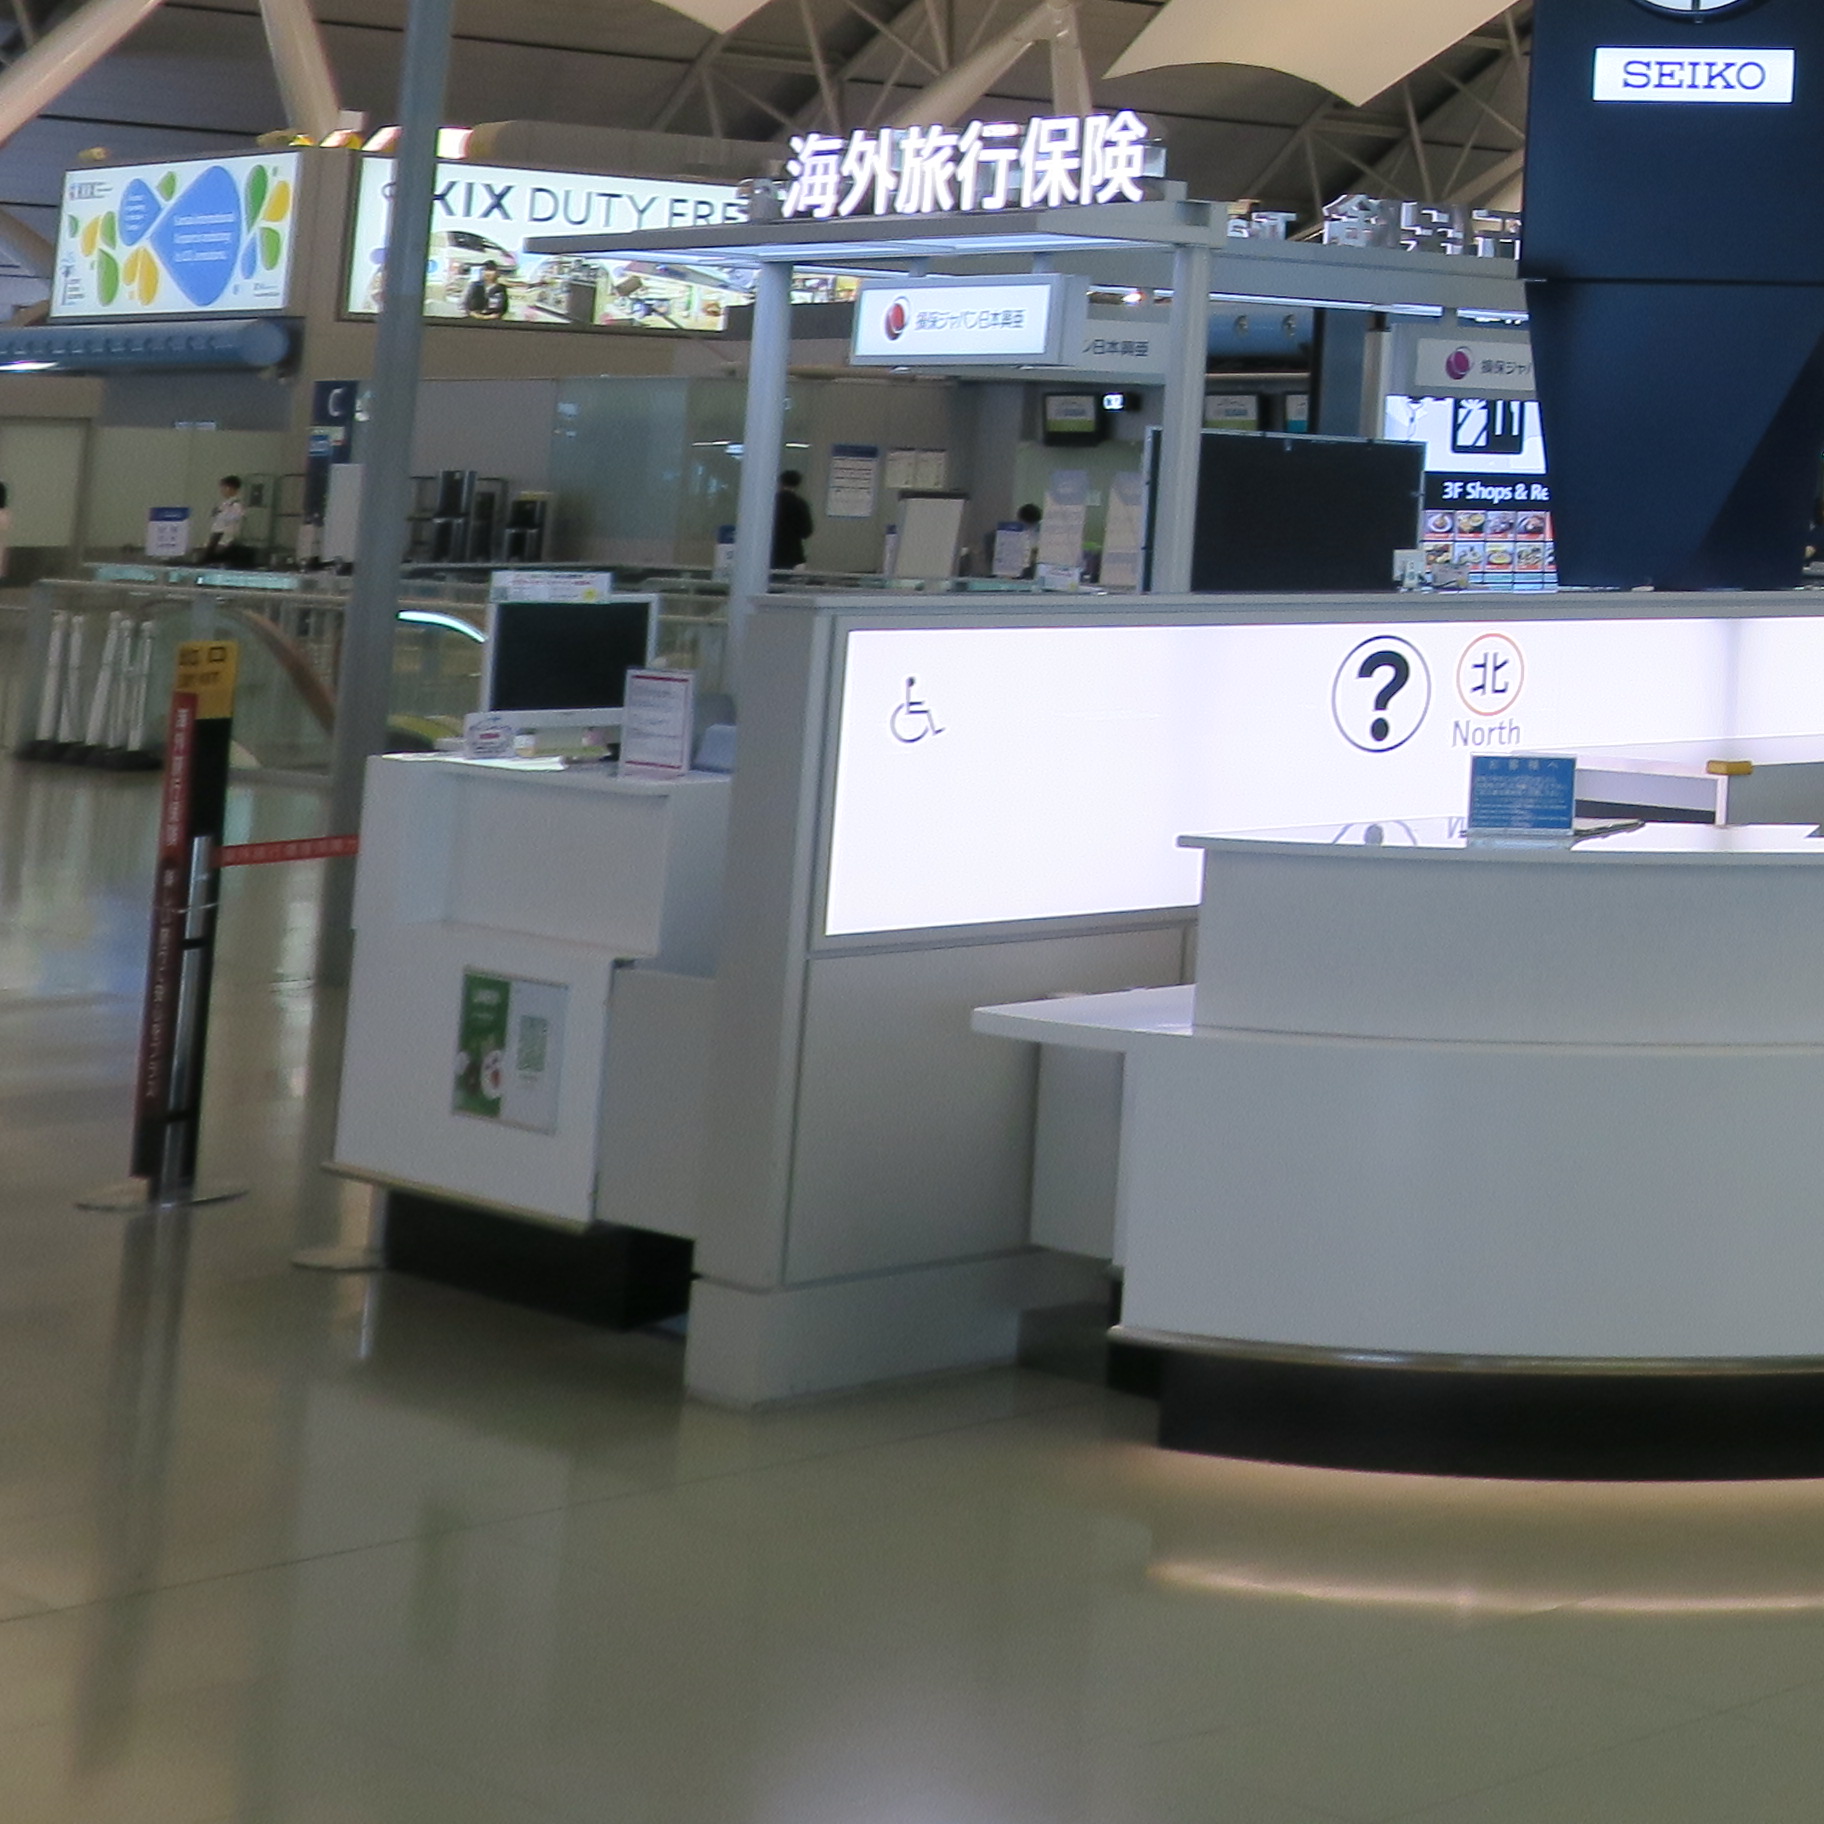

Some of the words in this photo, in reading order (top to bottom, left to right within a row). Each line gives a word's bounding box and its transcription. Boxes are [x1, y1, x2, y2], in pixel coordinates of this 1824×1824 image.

[1622, 60, 1767, 90] SEIKO
[781, 109, 1148, 220] 海外旅行保険
[527, 188, 659, 229] DUTY
[1442, 481, 1463, 499] 3F
[1465, 481, 1513, 504] Shops
[1514, 483, 1528, 500] &
[1530, 483, 1550, 501] Re
[1470, 651, 1510, 696] 北
[1451, 717, 1521, 748] North
